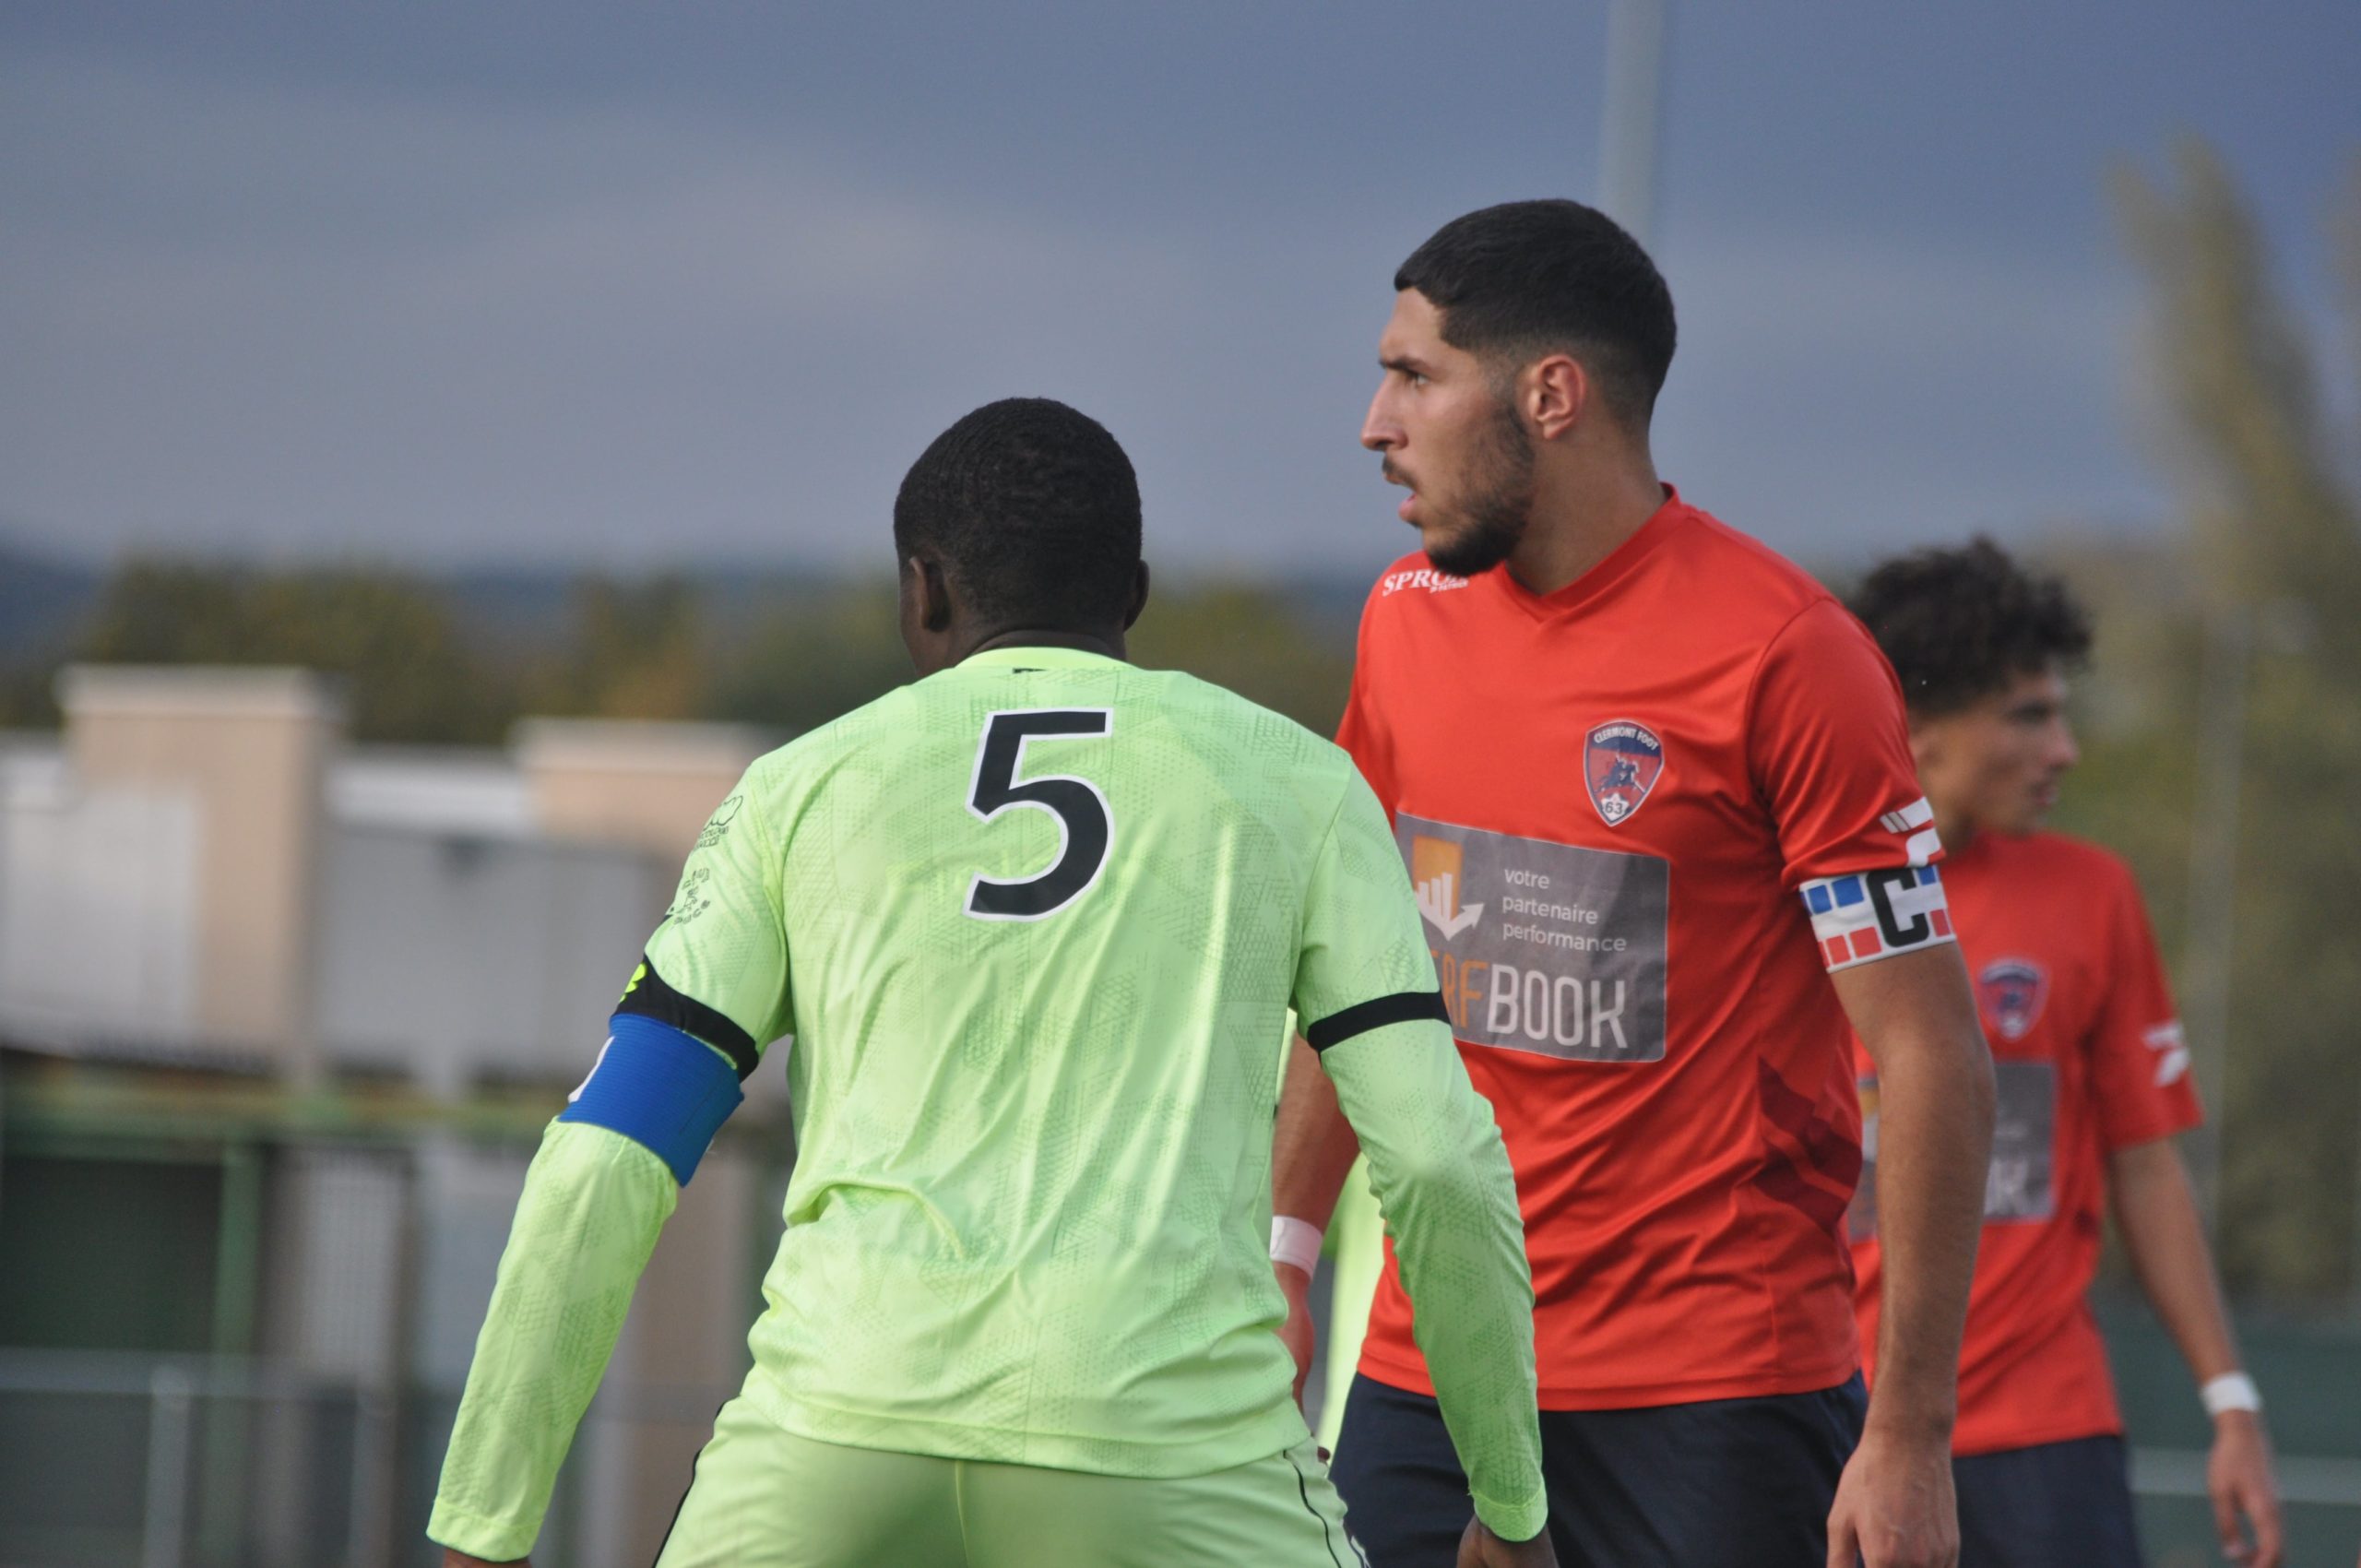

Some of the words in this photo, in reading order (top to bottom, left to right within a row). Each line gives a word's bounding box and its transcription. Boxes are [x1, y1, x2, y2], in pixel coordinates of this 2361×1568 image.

[1635, 730, 1659, 751] FOOT
[965, 708, 1114, 921] 5
[1604, 801, 1624, 815] 63
[1504, 868, 1550, 890] votre
[1501, 896, 1599, 924] partenaire
[1866, 867, 1930, 948] C
[1502, 921, 1628, 952] performance
[1430, 948, 1629, 1049] RFBOOK
